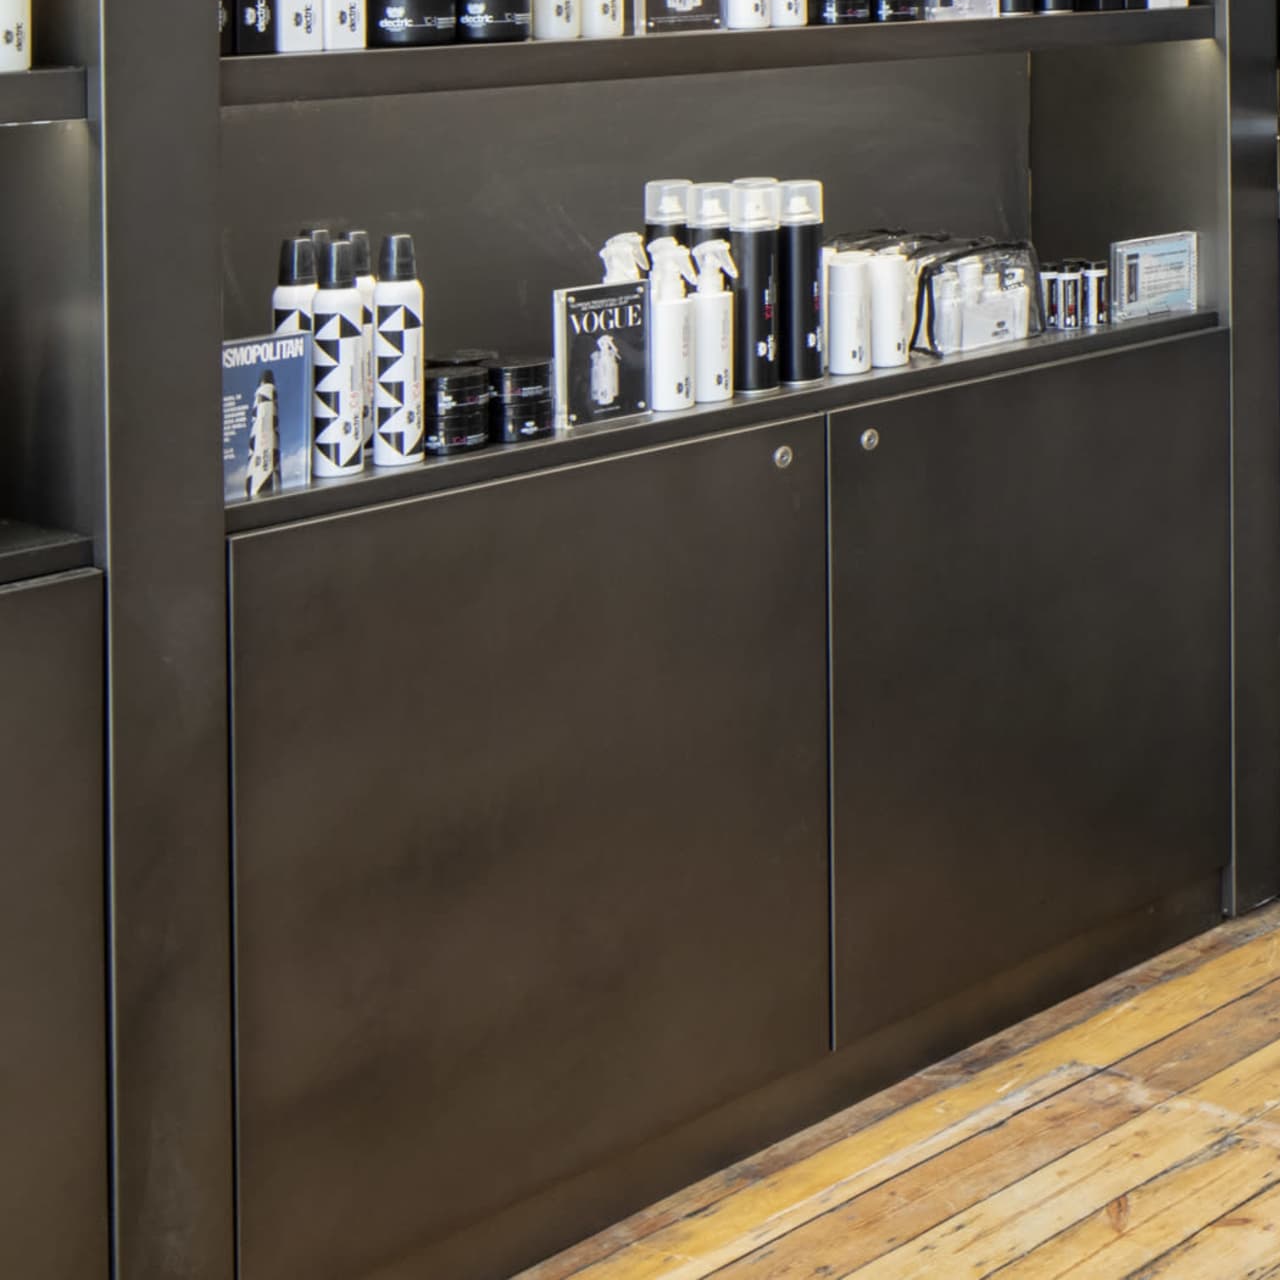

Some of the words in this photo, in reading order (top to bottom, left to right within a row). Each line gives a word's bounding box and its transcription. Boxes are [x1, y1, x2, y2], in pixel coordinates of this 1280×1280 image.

[304, 4, 313, 34] electric
[349, 2, 357, 33] electric
[379, 18, 414, 28] electric
[460, 15, 494, 24] electric
[569, 304, 642, 335] VOGUE
[223, 337, 304, 368] SMOPOLITAN
